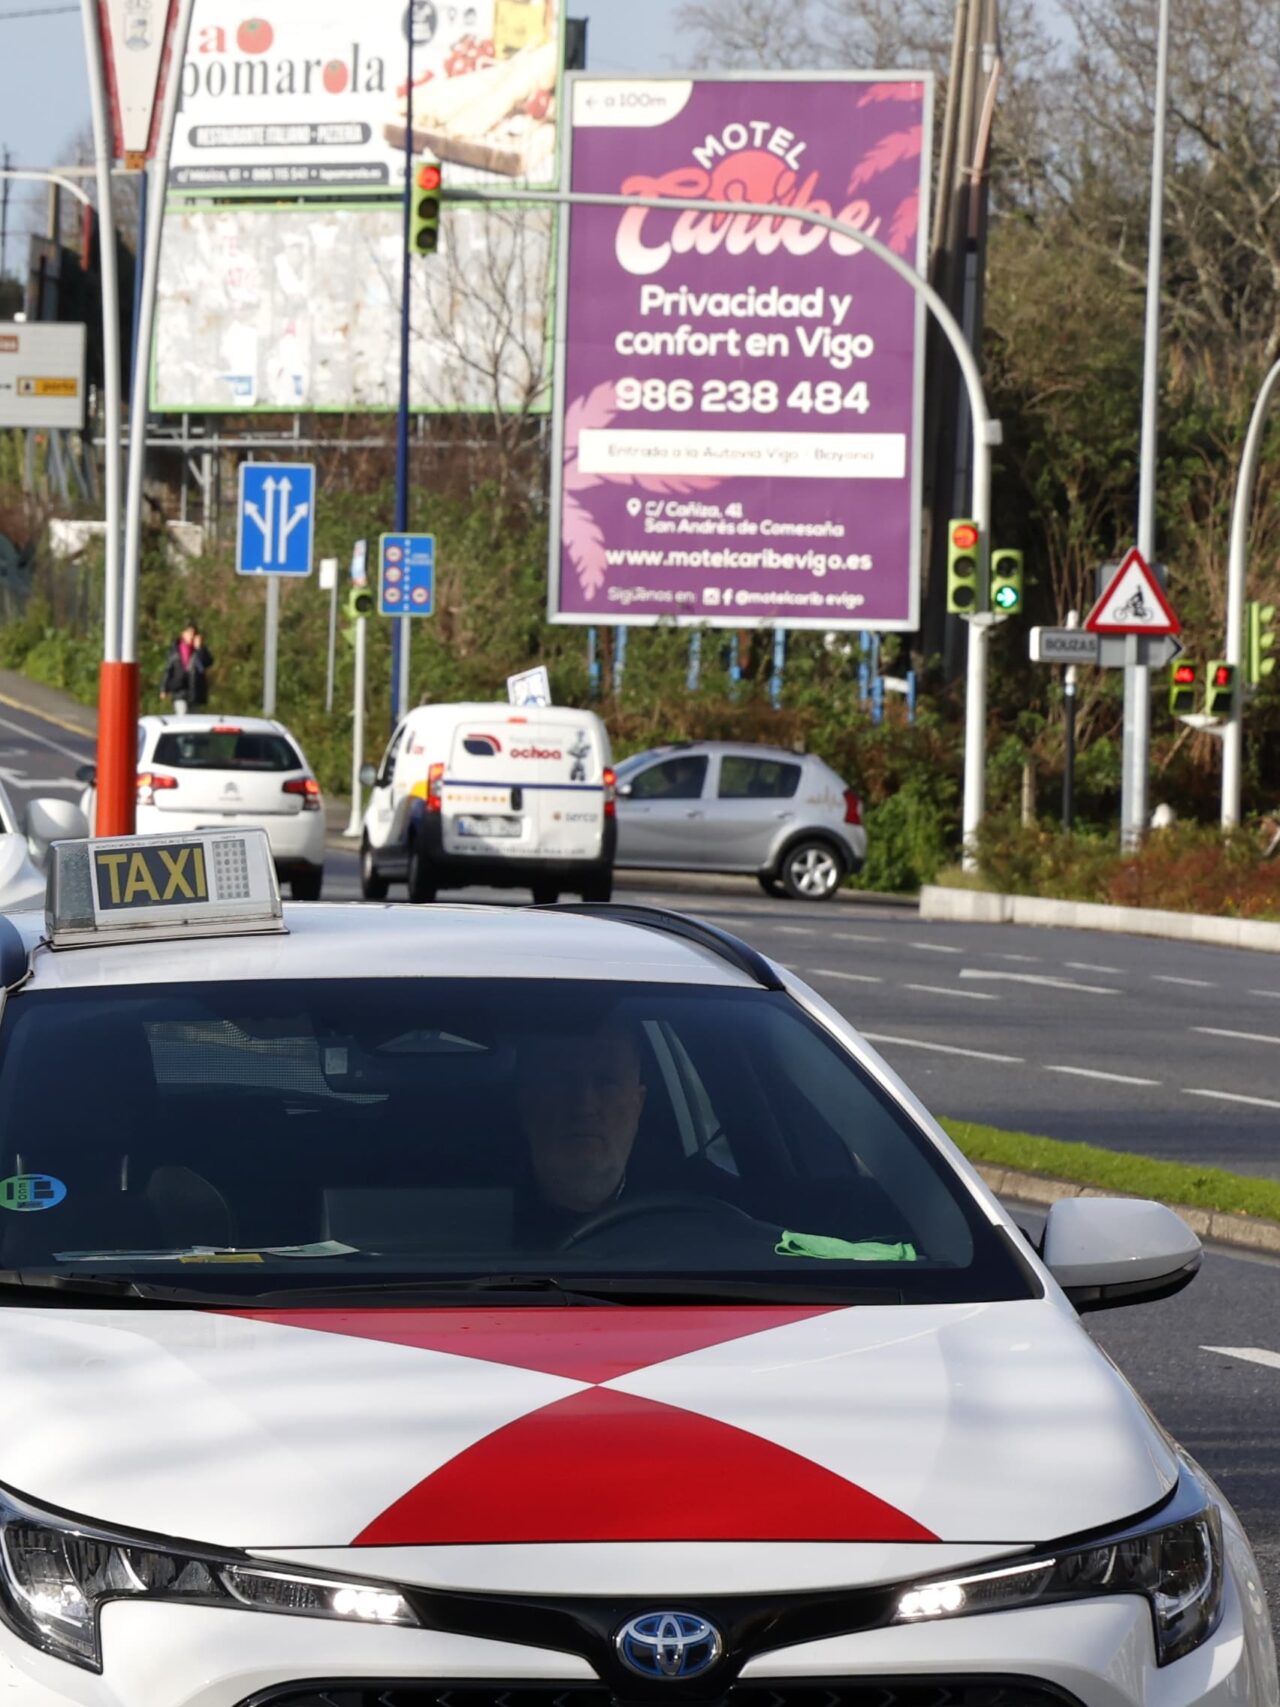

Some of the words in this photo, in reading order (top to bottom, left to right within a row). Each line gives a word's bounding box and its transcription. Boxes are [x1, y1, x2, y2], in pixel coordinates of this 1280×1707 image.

[619, 92, 666, 107] 100m
[692, 120, 807, 170] MOTEL
[615, 167, 882, 275] Caribe
[640, 284, 824, 318] Privacidad
[830, 293, 853, 325] y
[615, 325, 741, 356] confort
[745, 334, 789, 357] en
[796, 326, 874, 369] Vigo
[616, 377, 694, 412] 986
[700, 378, 779, 413] 238
[786, 380, 871, 415] 484
[608, 443, 669, 458] Entrada
[766, 447, 799, 464] Vigo
[644, 517, 677, 534] San
[677, 518, 735, 536] Andrés
[736, 519, 758, 535] de
[759, 519, 845, 538] Comesaña
[605, 548, 873, 576] www.motelcaribevigo.es
[1045, 638, 1097, 651] BOUZAS
[509, 745, 562, 760] ochoa
[96, 847, 207, 904] TAXI
